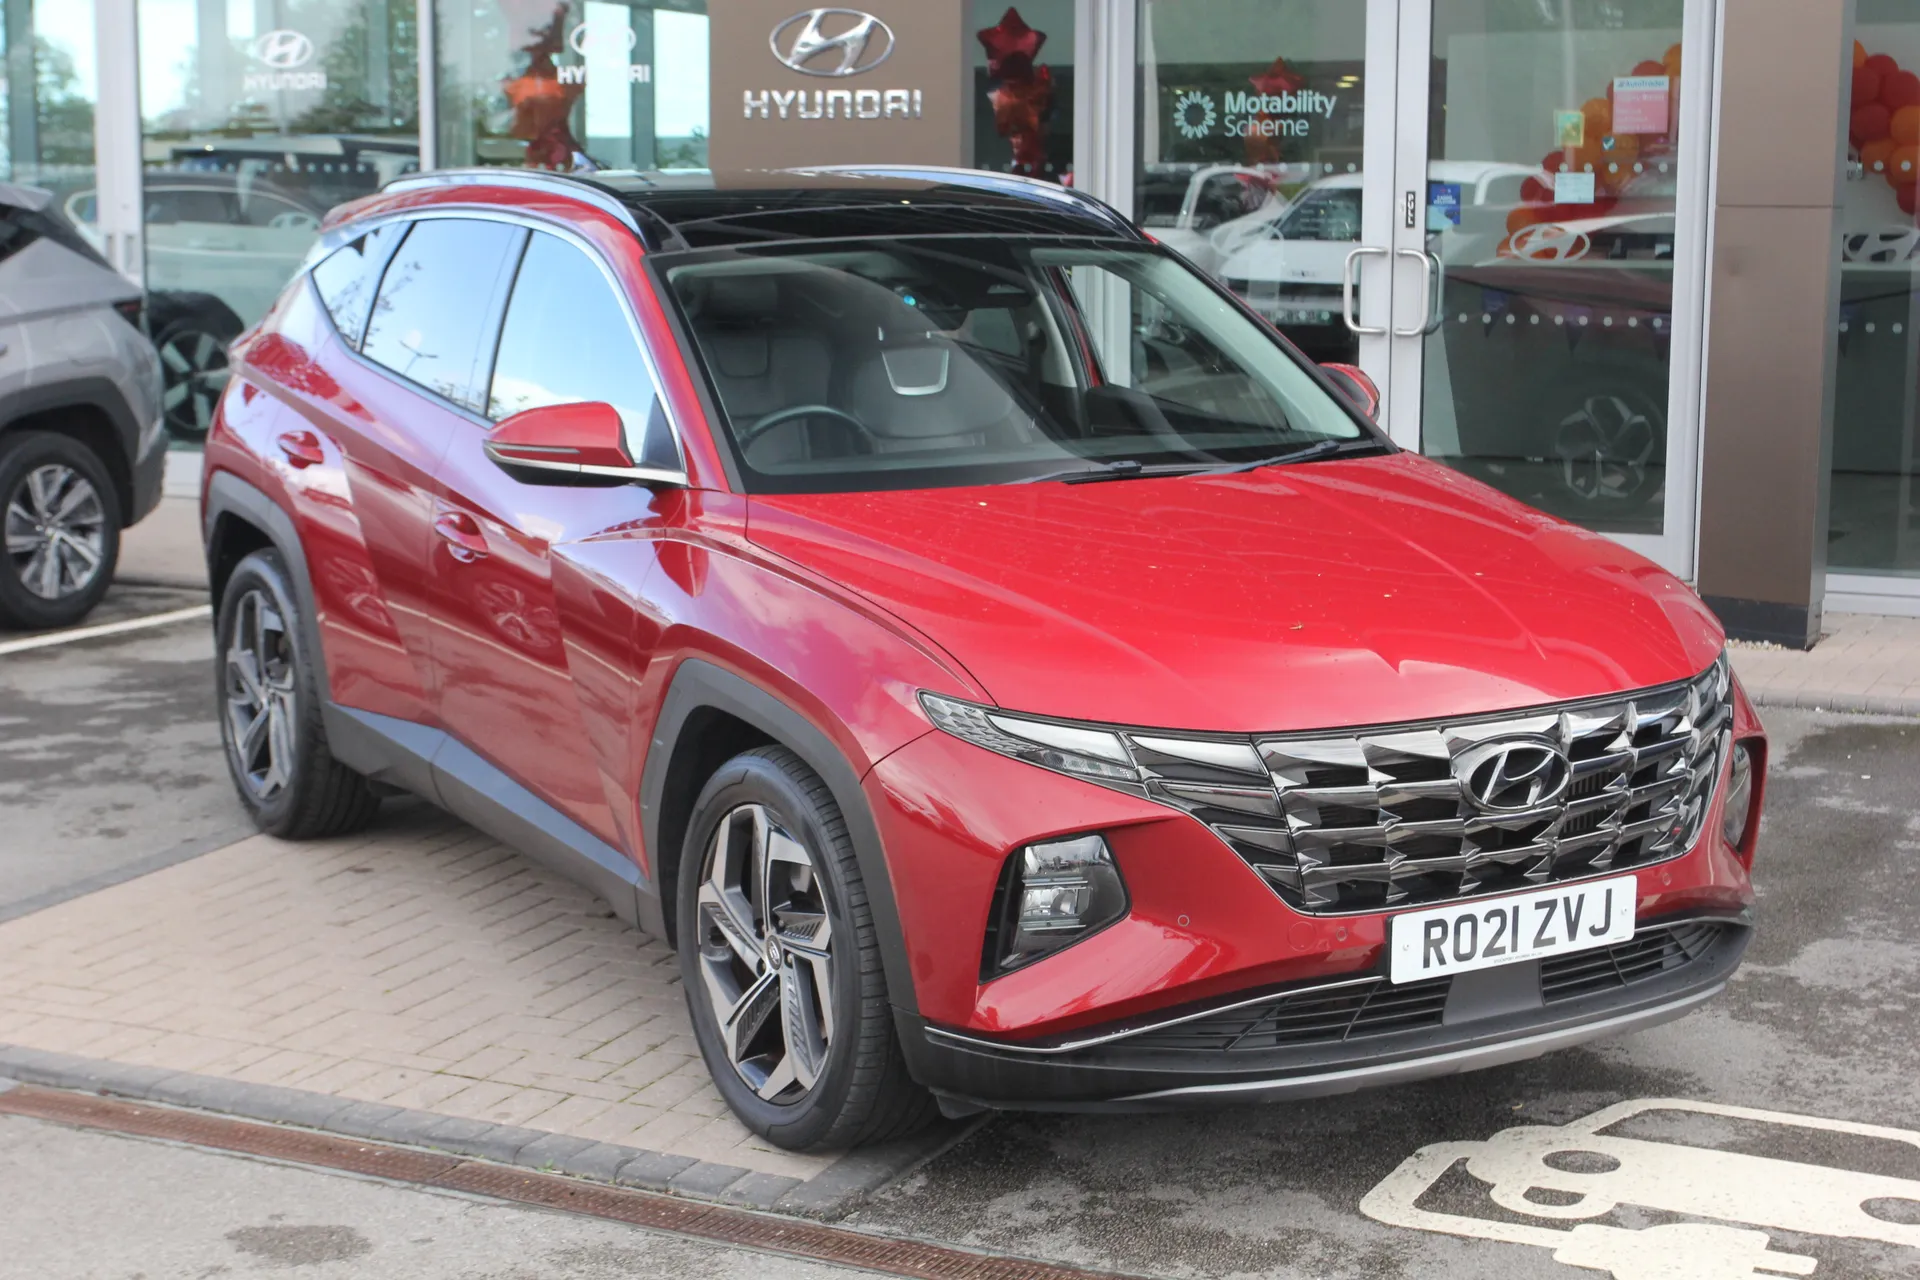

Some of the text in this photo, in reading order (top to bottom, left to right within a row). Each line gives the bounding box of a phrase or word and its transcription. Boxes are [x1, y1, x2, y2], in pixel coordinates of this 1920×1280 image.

[557, 65, 650, 84] HYAI
[743, 90, 922, 119] HYUNDAI
[1224, 90, 1337, 119] Motability
[1224, 115, 1309, 137] Scheme
[1407, 192, 1415, 225] PULL
[1423, 888, 1613, 969] RO21 ZVJ
